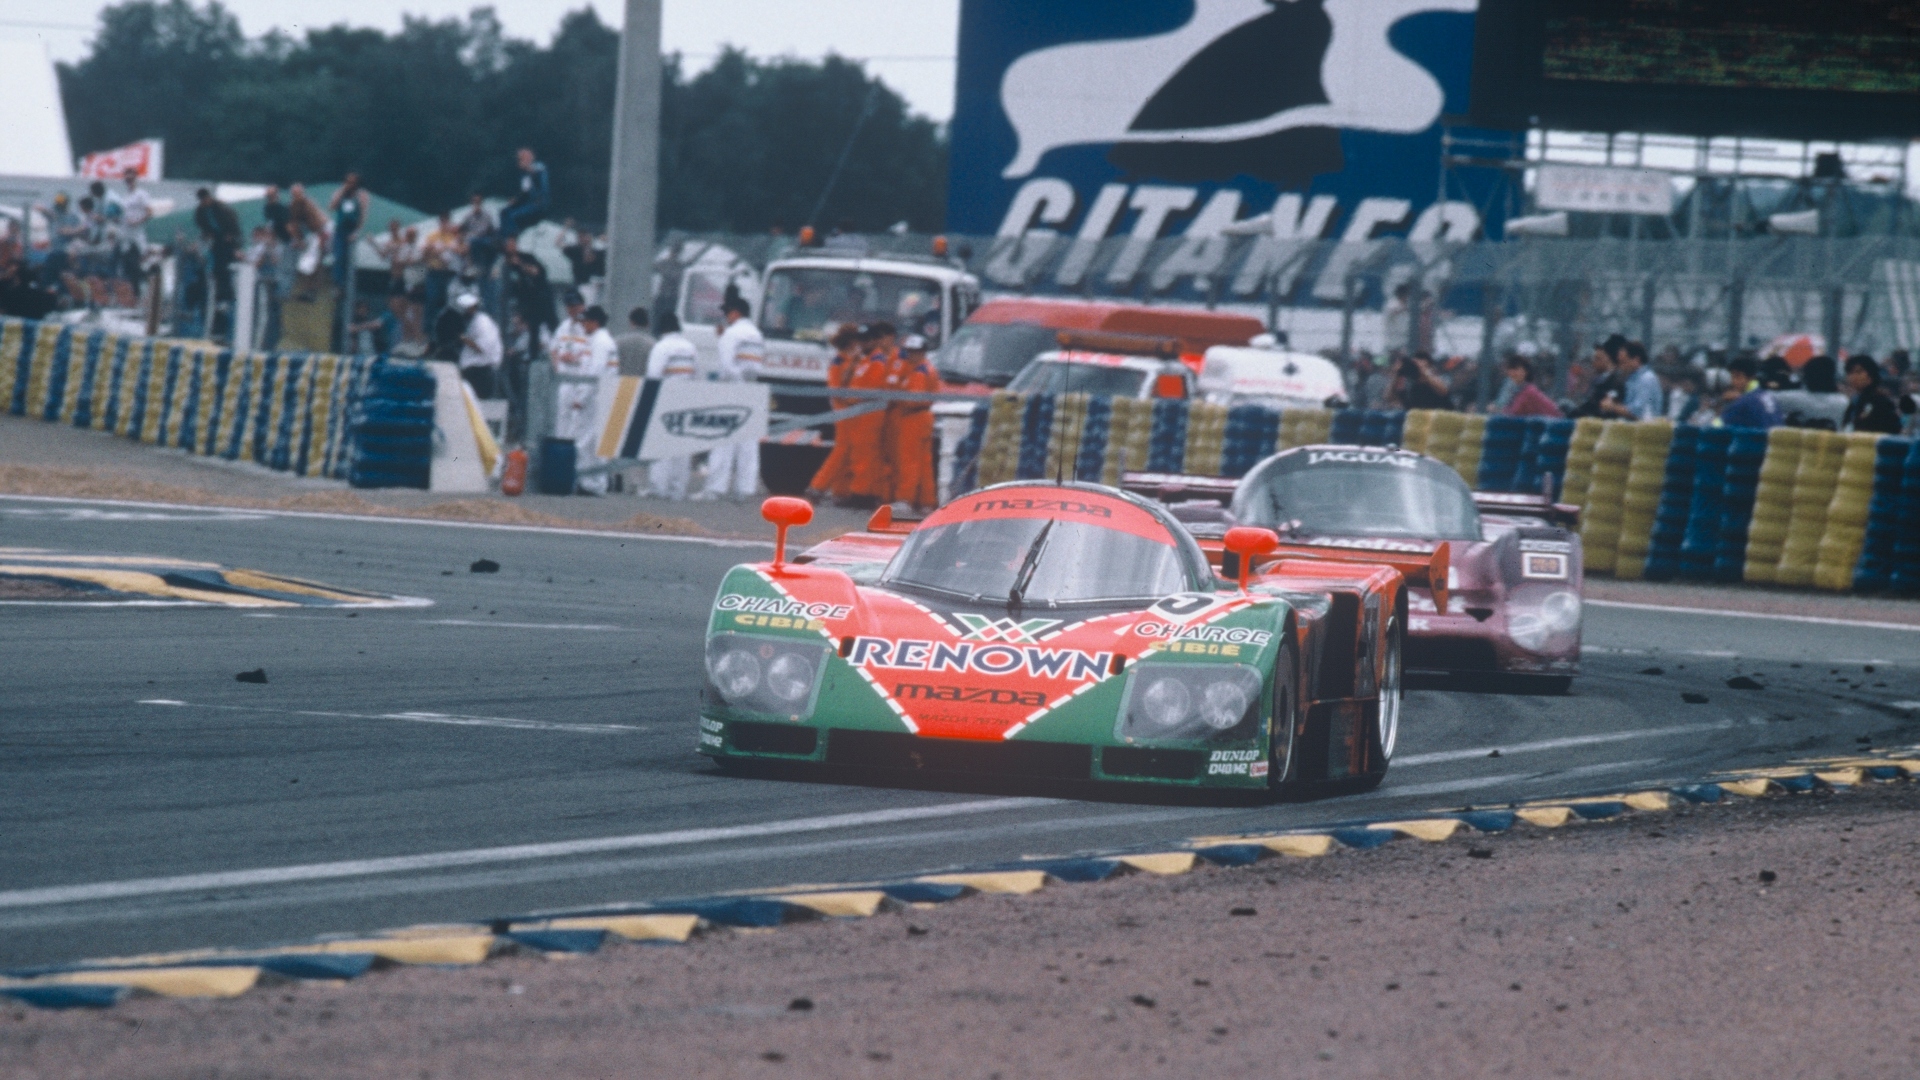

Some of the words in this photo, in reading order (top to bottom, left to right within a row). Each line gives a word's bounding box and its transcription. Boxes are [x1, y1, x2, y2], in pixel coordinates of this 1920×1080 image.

[1307, 451, 1417, 469] JAGUAR
[717, 594, 853, 620] CHARGE
[734, 613, 826, 631] CIBIE
[1135, 622, 1273, 647] CHARGE
[1148, 641, 1241, 656] CIBIE
[849, 636, 1113, 682] RENOWN
[1209, 749, 1260, 762] DUNLOP
